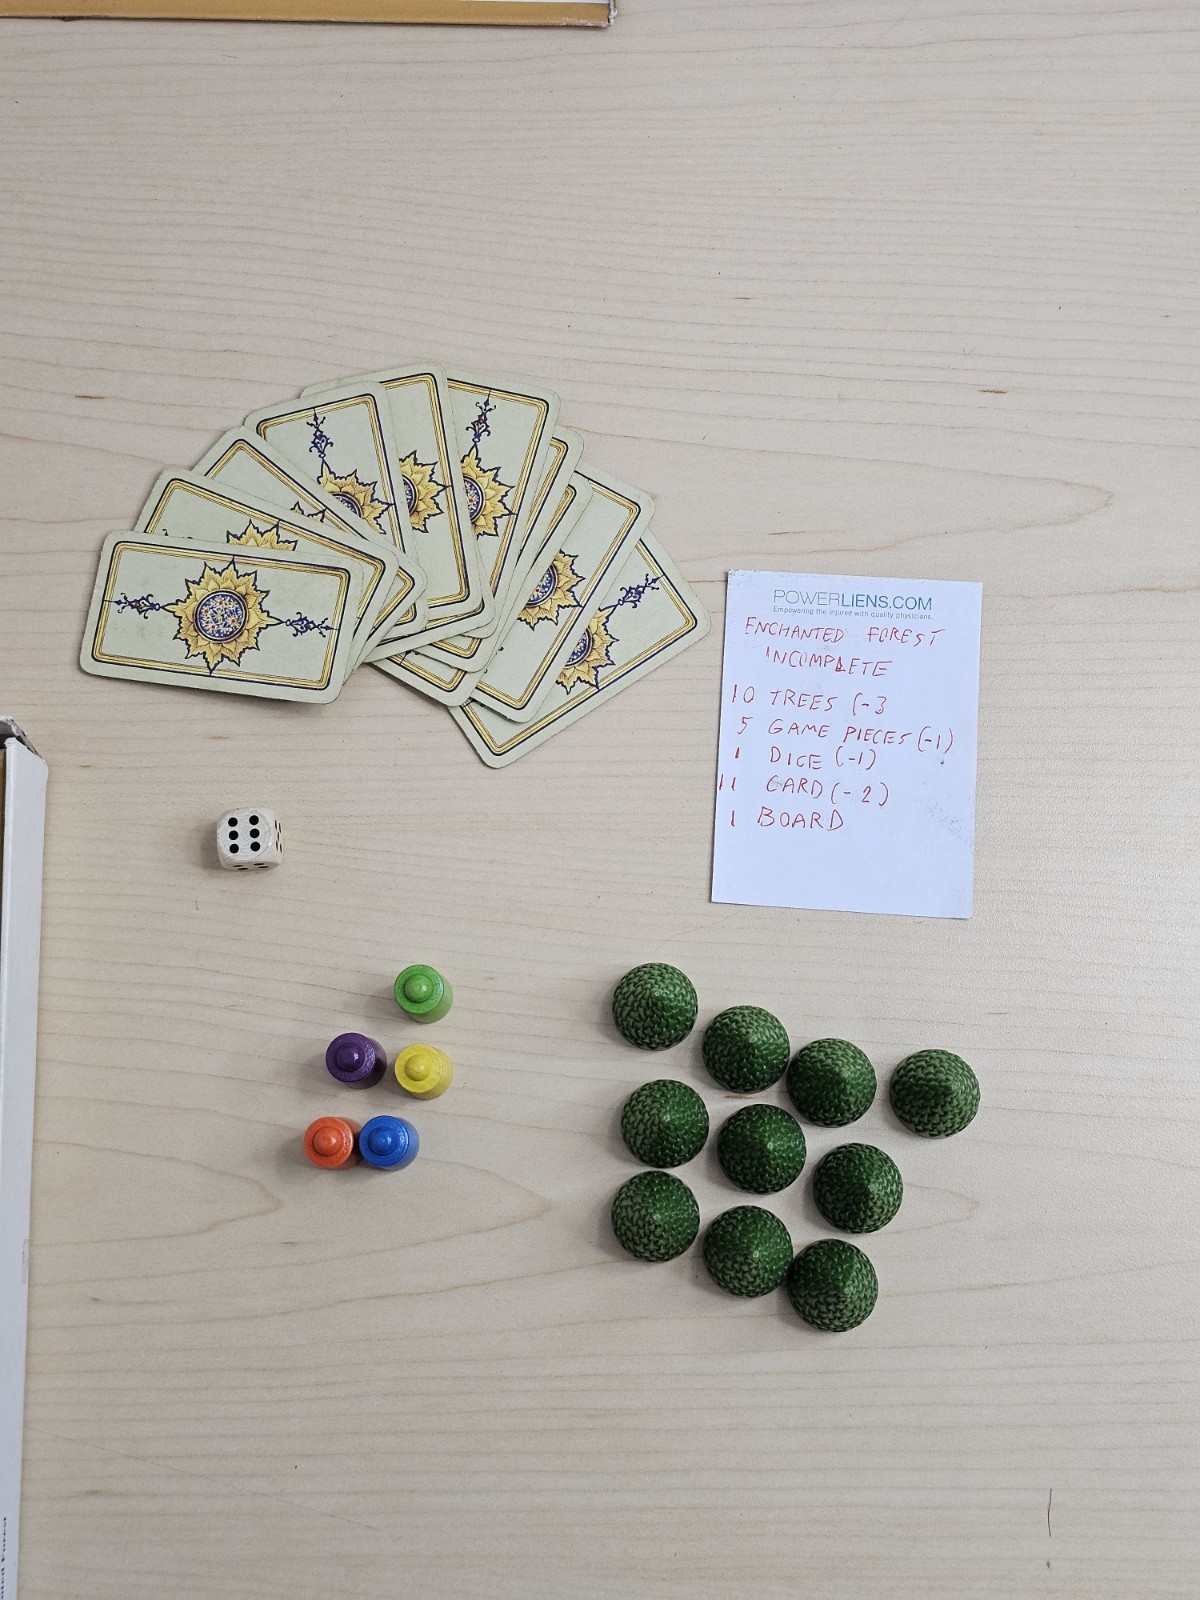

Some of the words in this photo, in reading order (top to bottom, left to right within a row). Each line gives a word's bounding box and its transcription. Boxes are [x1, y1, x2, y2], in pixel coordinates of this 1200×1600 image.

[773, 589, 932, 611] POWERLIENS.COM
[773, 605, 814, 616] Empowering
[815, 608, 828, 616] the
[829, 608, 852, 617] injured
[853, 609, 869, 618] with
[870, 610, 894, 620] quality
[895, 613, 935, 621] physicians.
[745, 616, 844, 643] ENCHANTED
[867, 626, 945, 646] FOREST
[766, 646, 892, 676] INCOMPLETE
[731, 683, 755, 704] 10
[769, 688, 839, 712] TREES
[736, 716, 754, 735] 5
[767, 718, 831, 739] GAME
[842, 726, 912, 745] PIECES
[917, 725, 954, 755] (-1)
[734, 746, 740, 760] 1
[769, 745, 823, 771] DICE
[835, 745, 877, 771] (-1)
[718, 774, 737, 792] 11
[765, 774, 824, 800] CARD
[730, 809, 736, 828] 1
[757, 806, 844, 831] BOARD
